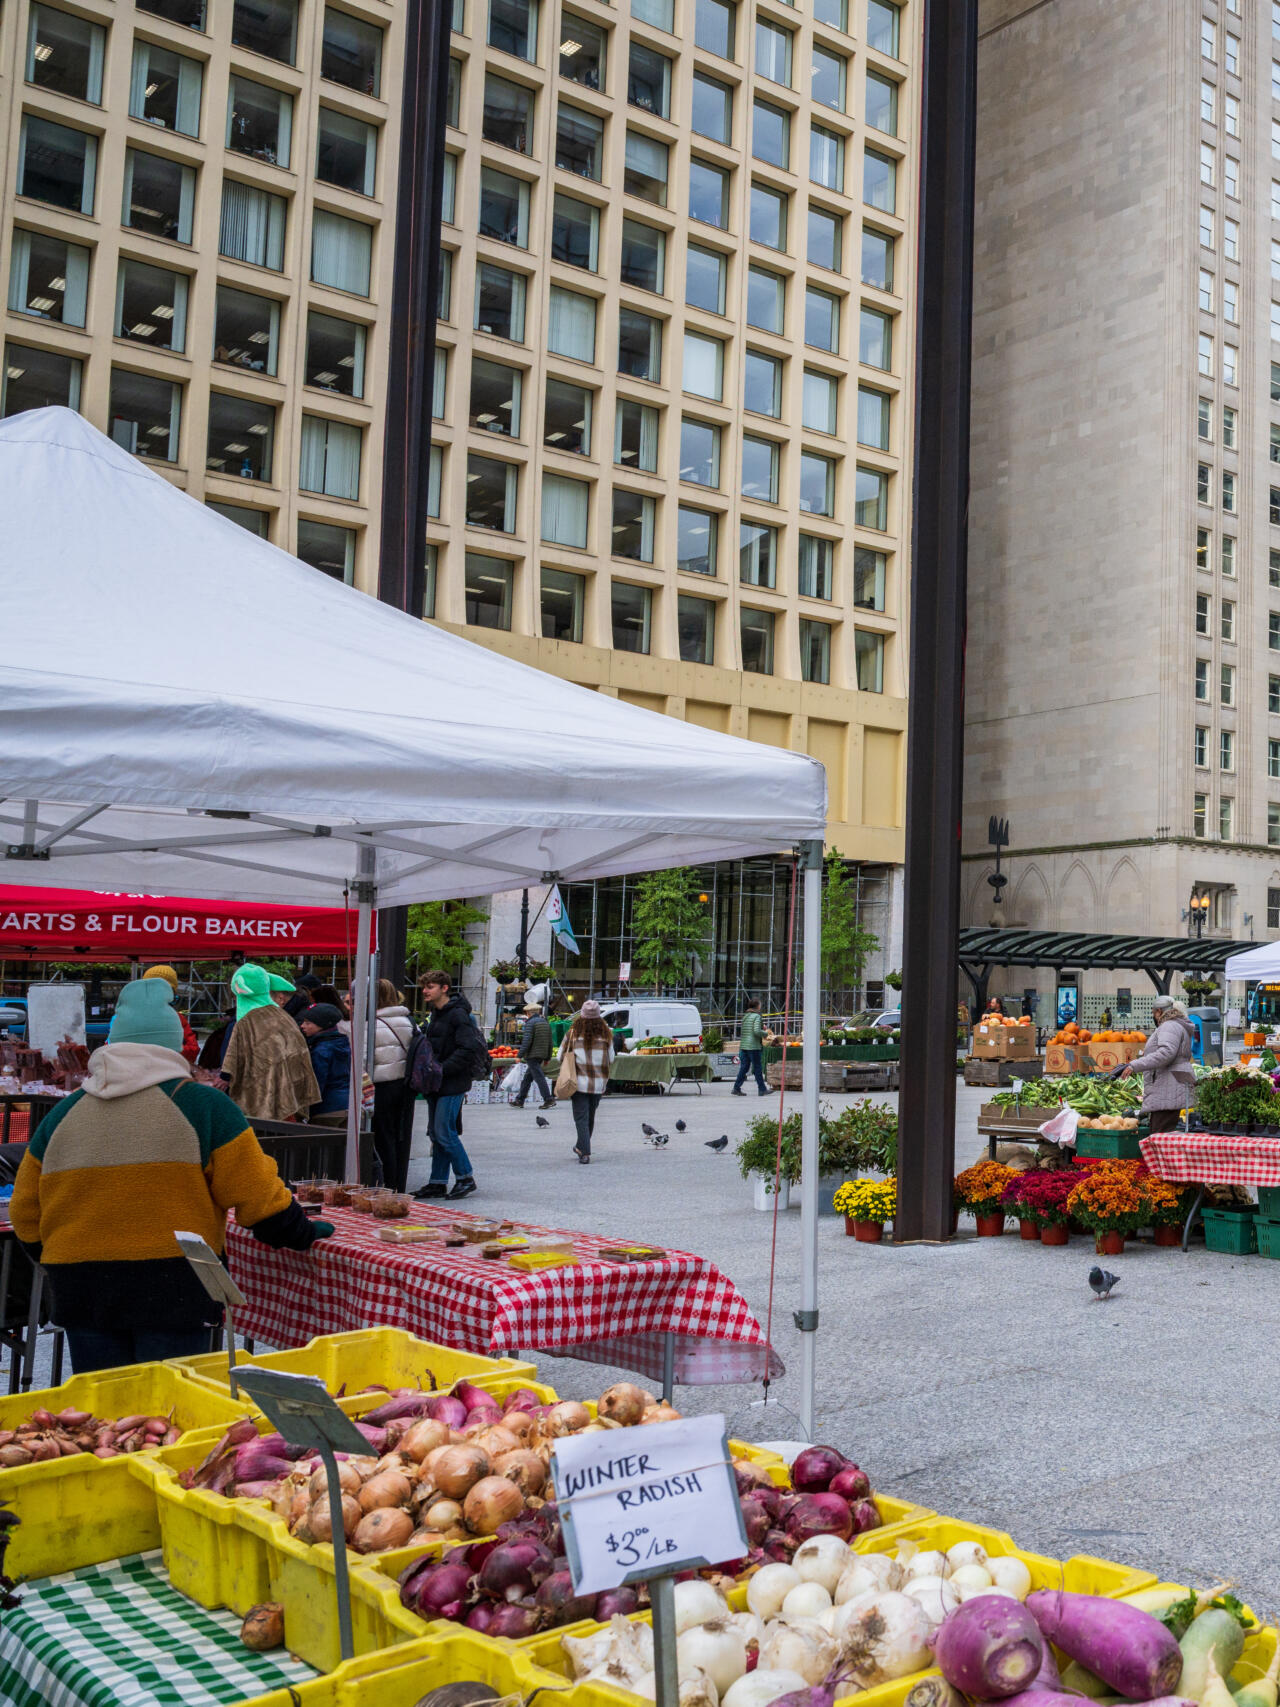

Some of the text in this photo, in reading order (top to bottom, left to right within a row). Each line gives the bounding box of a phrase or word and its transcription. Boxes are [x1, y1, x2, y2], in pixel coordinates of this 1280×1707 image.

[0, 912, 303, 938] ARTS & FLOUR BAKERY
[565, 1454, 661, 1498] WINTER
[616, 1472, 703, 1511] RADISH
